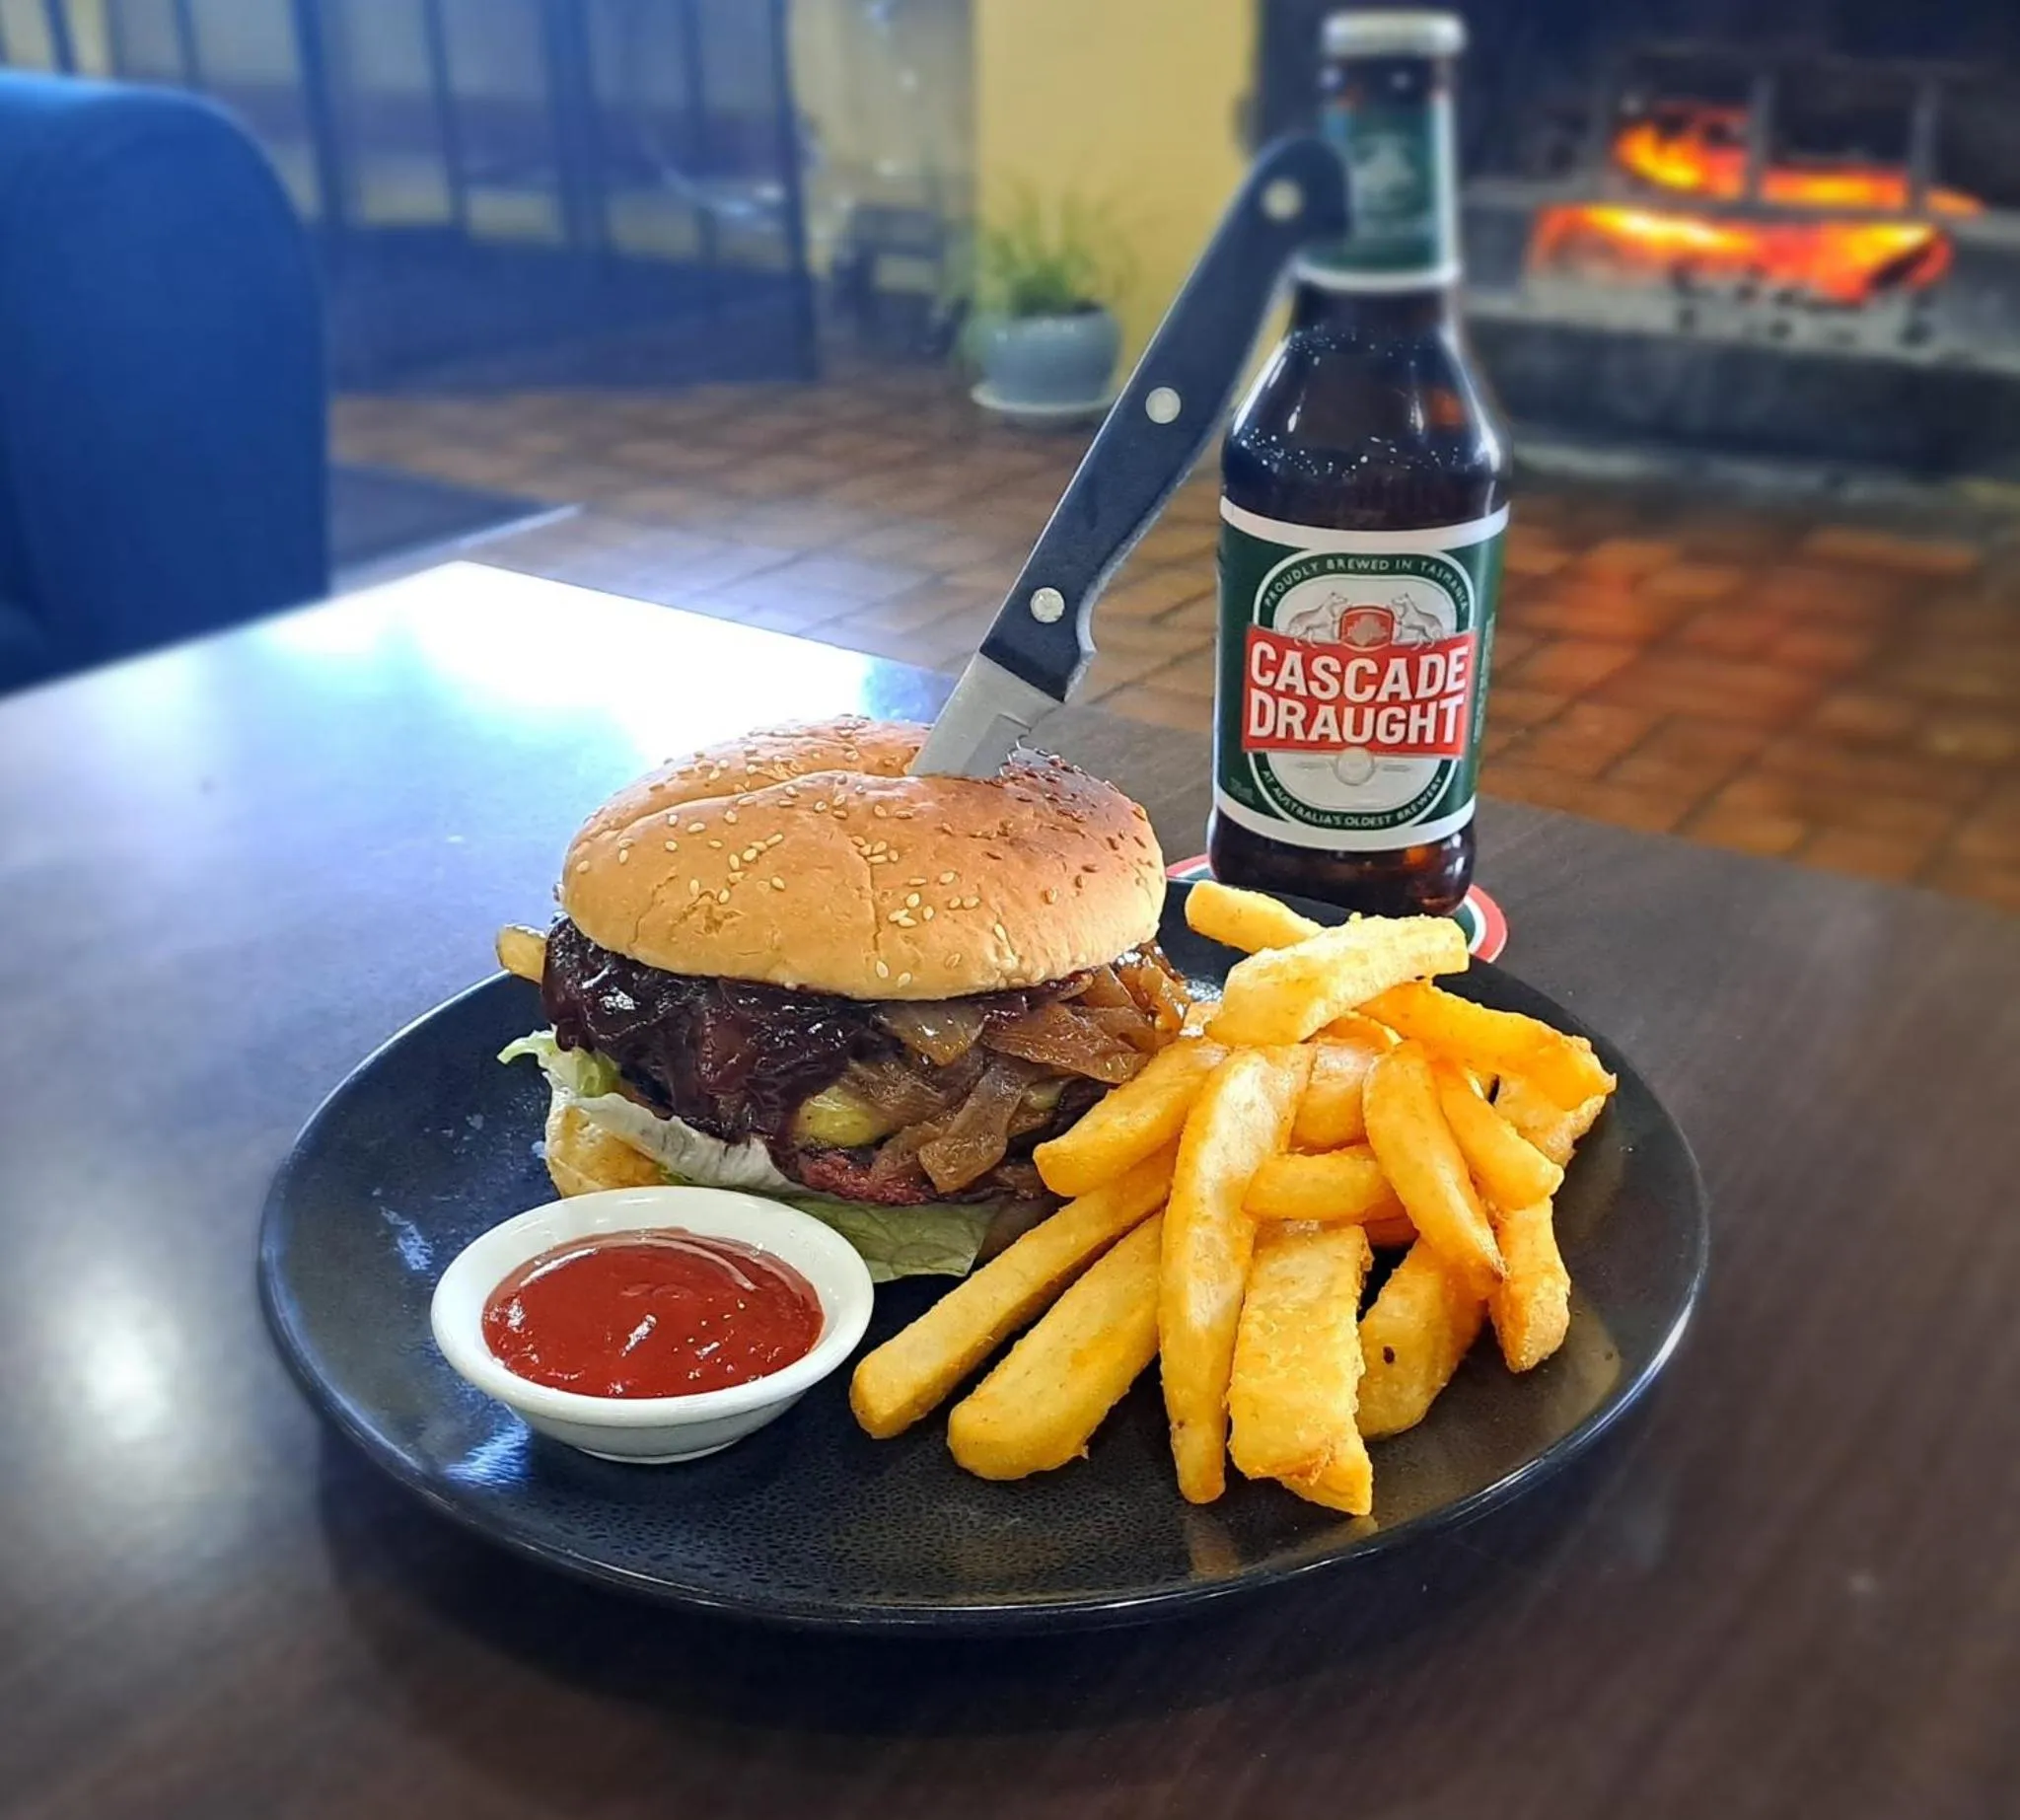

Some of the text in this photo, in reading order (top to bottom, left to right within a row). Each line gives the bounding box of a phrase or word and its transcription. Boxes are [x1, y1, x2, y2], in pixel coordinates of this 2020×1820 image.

[1263, 558, 1469, 613] PROUDLY BREWED IN TASMANIA
[1250, 640, 1469, 702] CASCADE
[1248, 687, 1466, 745] DRAUGHT
[1272, 787, 1341, 827] AUSTRALIA'S
[1342, 815, 1392, 828] OLDEST
[1397, 775, 1443, 821] BREWERY
